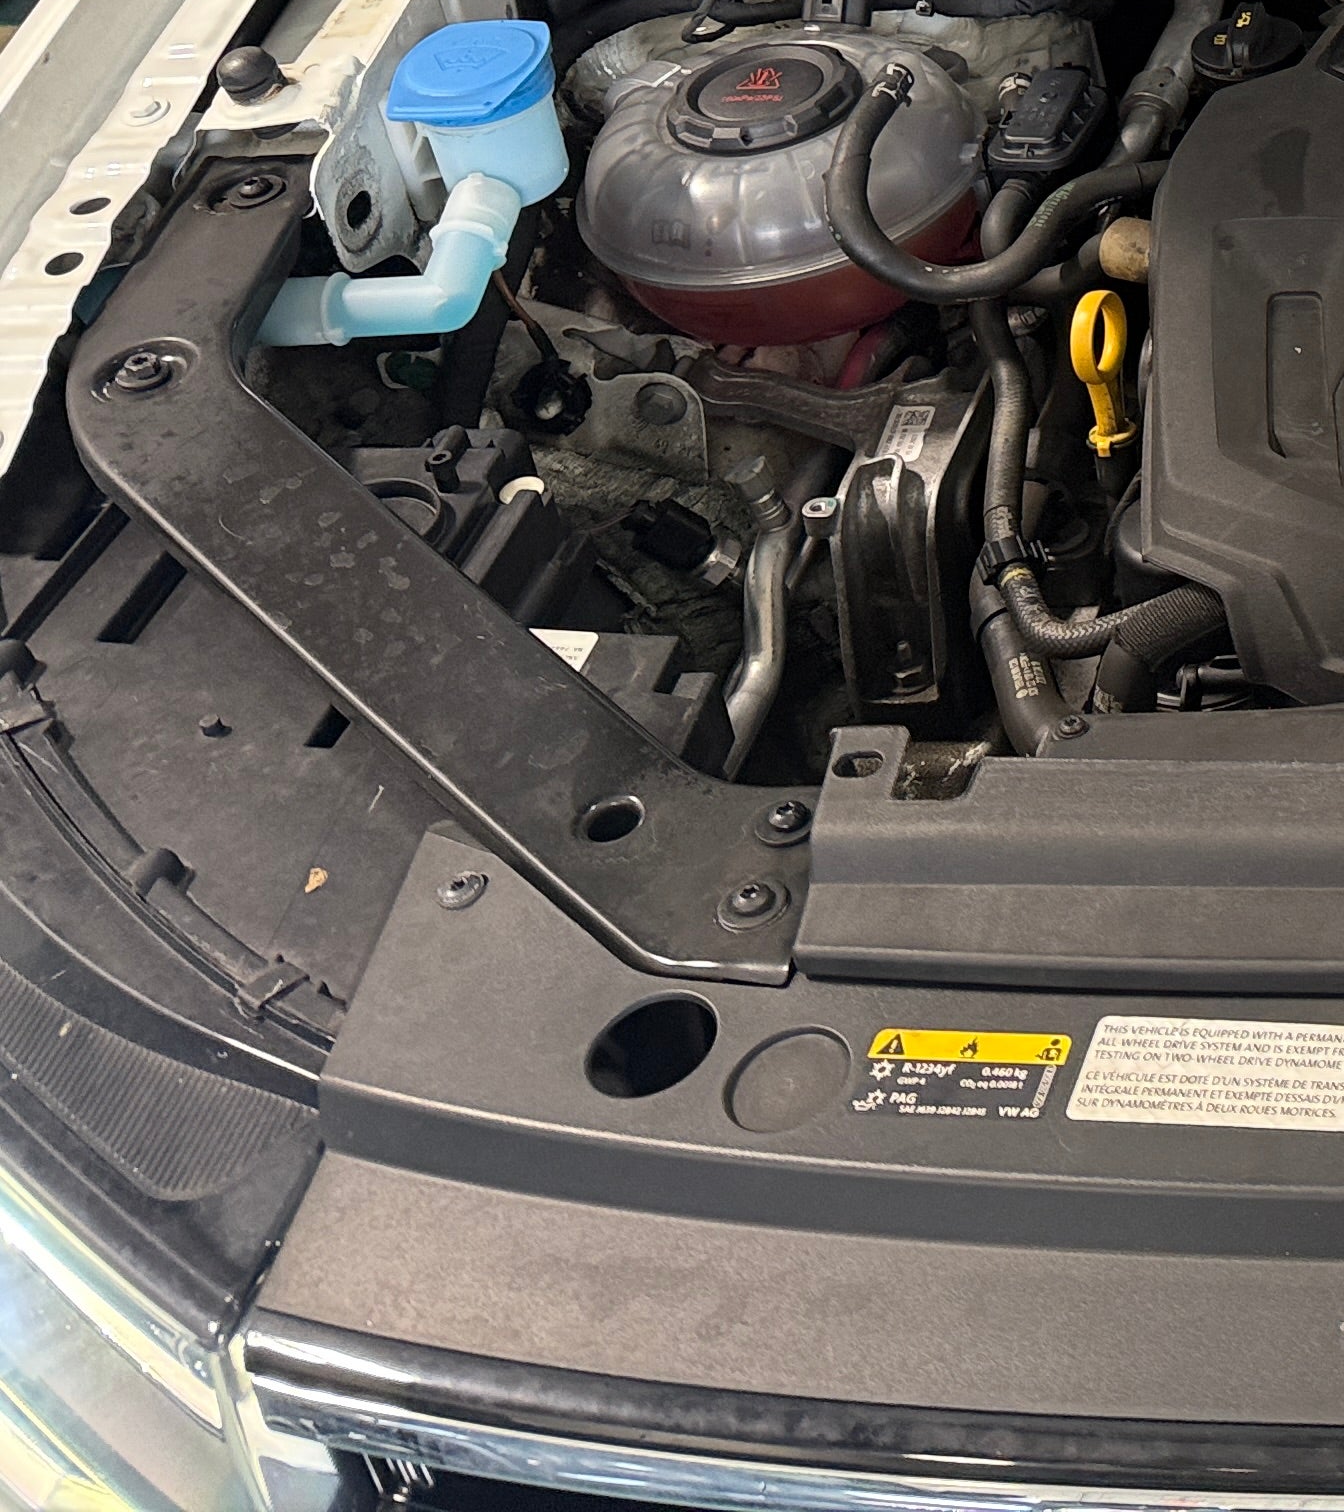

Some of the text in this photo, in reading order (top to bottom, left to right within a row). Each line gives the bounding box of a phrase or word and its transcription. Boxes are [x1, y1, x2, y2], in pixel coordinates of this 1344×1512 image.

[1104, 1024, 1128, 1034] THIS
[1132, 1026, 1178, 1036] VEHICLE
[1180, 1027, 1190, 1036] IS
[1193, 1028, 1249, 1039] EQUIPPED
[1252, 1031, 1282, 1040] WITH
[1285, 1032, 1293, 1040] A
[1163, 1040, 1200, 1049] DRIVE
[1200, 1042, 1242, 1051] SYSTEM
[1244, 1043, 1271, 1053] AND
[1273, 1045, 1282, 1053] IS
[1286, 1045, 1330, 1055] EXEMPT
[1095, 1050, 1141, 1060] TESTING
[1143, 1052, 1161, 1061] ON
[1238, 1056, 1272, 1066] DRIVE
[901, 1062, 956, 1077] R-1234yf
[982, 1067, 1013, 1077] 0.460
[1086, 1071, 1100, 1080] CE
[1103, 1070, 1156, 1082] VÉHICULE
[1158, 1074, 1176, 1083] EST
[1292, 1079, 1308, 1089] DE
[889, 1092, 918, 1104] PAG
[1081, 1083, 1139, 1095] INTÉGRALE
[1141, 1086, 1208, 1099] PERMANENT
[1210, 1089, 1223, 1099] ET
[998, 1106, 1040, 1118] VW AG
[1077, 1098, 1100, 1107] SUR
[1206, 1102, 1238, 1114] DEUX
[1239, 1105, 1278, 1115] ROUES
